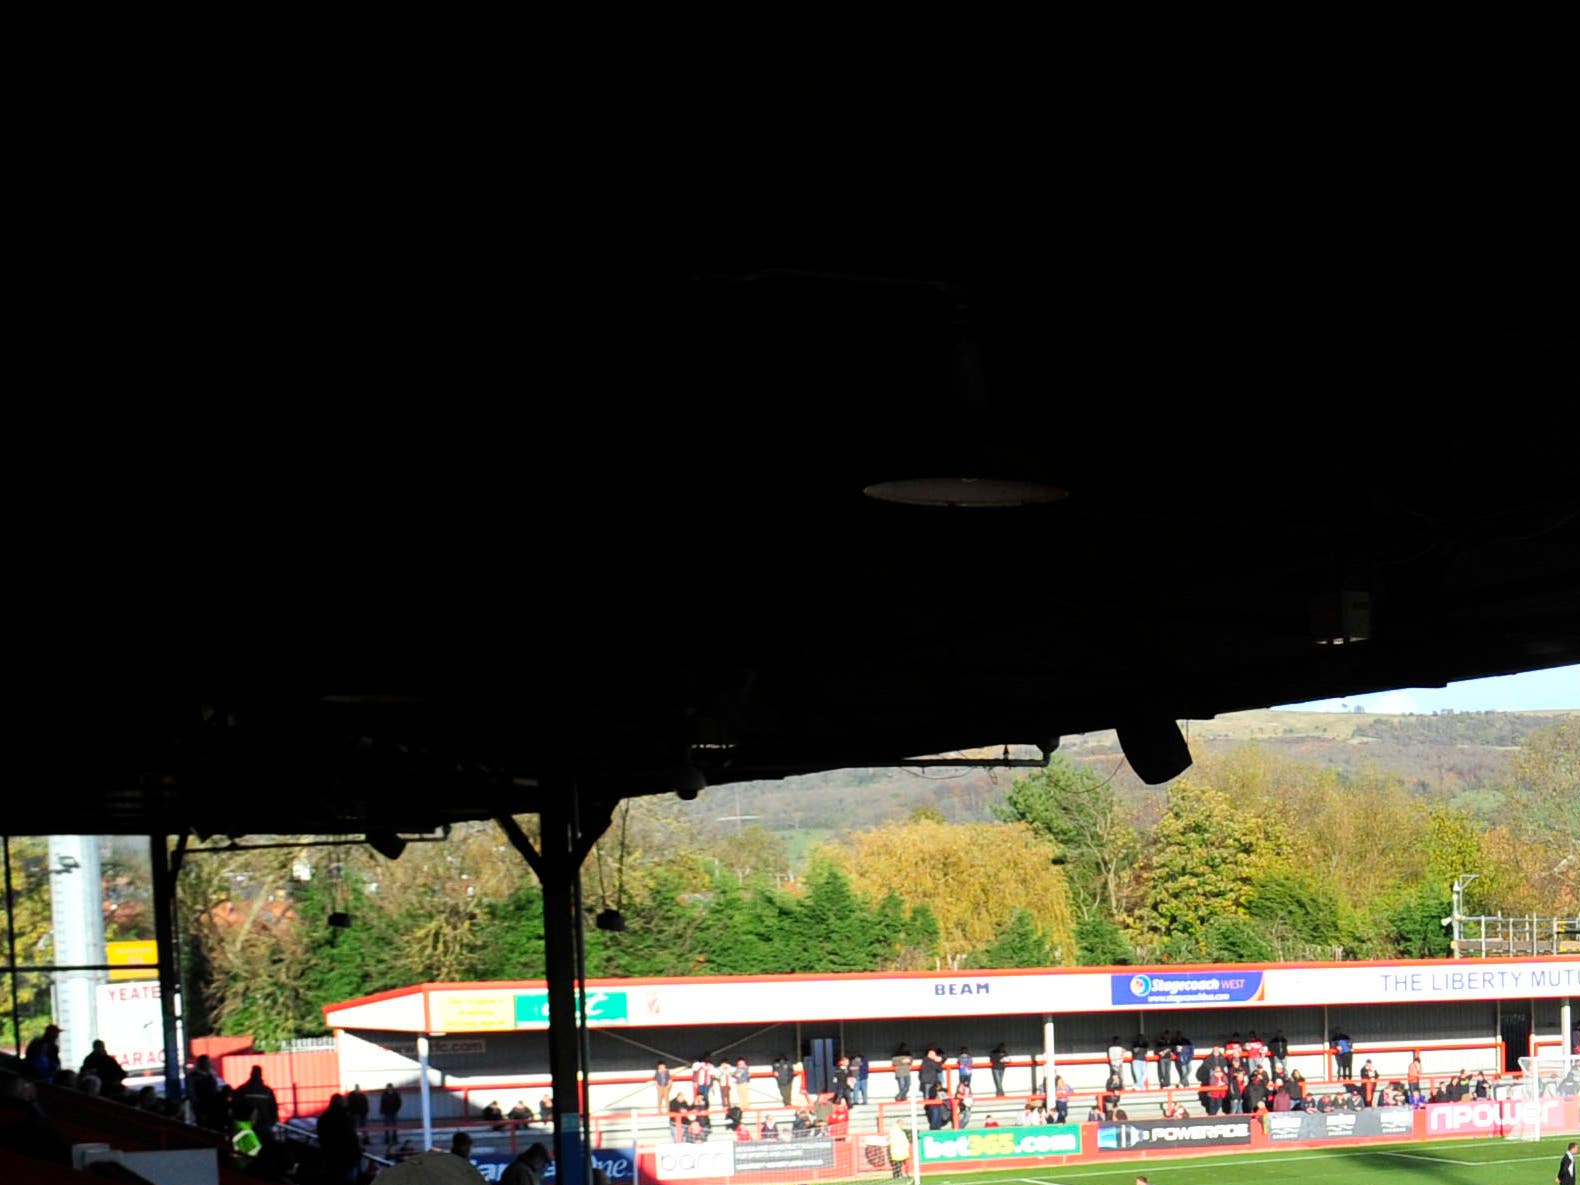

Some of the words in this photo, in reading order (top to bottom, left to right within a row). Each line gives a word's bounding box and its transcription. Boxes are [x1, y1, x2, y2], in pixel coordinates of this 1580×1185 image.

[934, 983, 990, 996] BEAM
[1151, 978, 1219, 994] Stagecoach
[1221, 979, 1245, 989] WEST
[1380, 974, 1423, 992] THE
[1432, 971, 1522, 991] LIBERTY
[1150, 1124, 1250, 1142] POWERADE
[923, 1133, 1076, 1158] bet365.com
